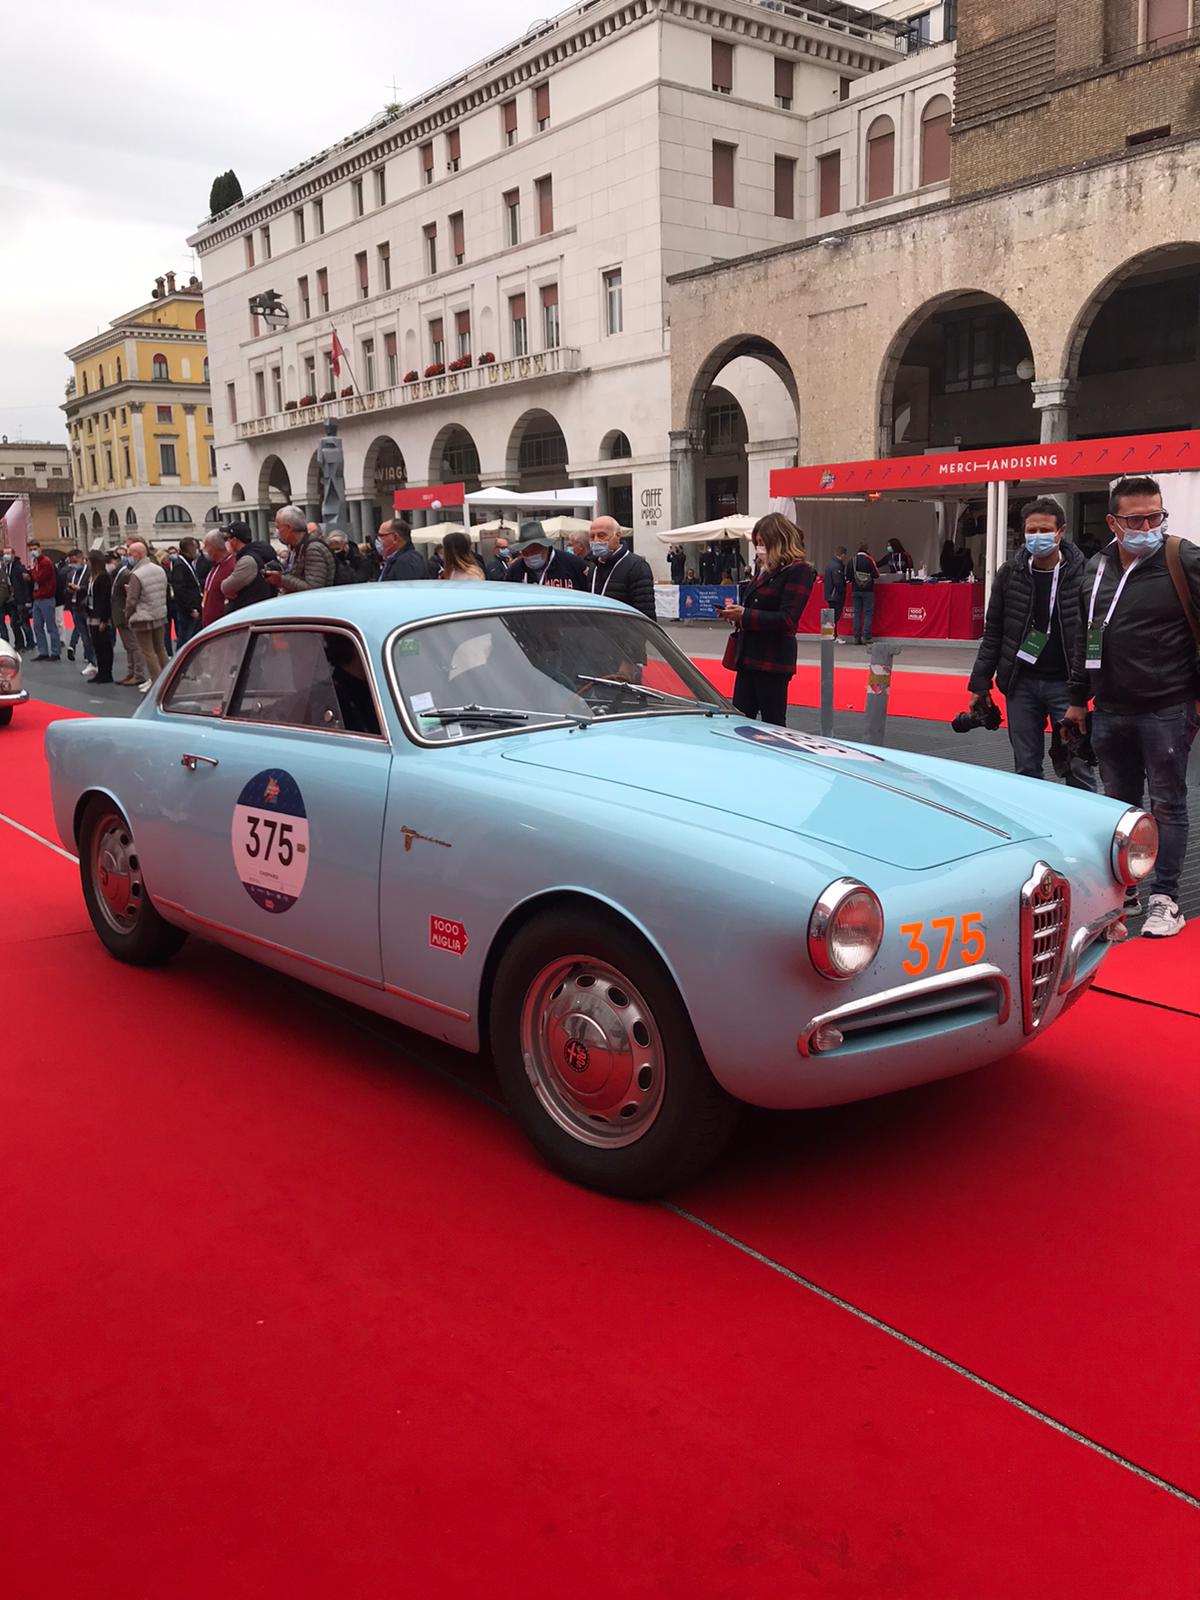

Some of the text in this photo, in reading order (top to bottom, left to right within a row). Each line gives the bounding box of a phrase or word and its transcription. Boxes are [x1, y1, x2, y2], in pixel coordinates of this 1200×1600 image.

[938, 454, 1058, 475] MERCHANDISING
[245, 815, 293, 867] 375
[433, 920, 460, 936] 1000
[431, 933, 462, 951] MIGLIA
[900, 912, 986, 976] 375
